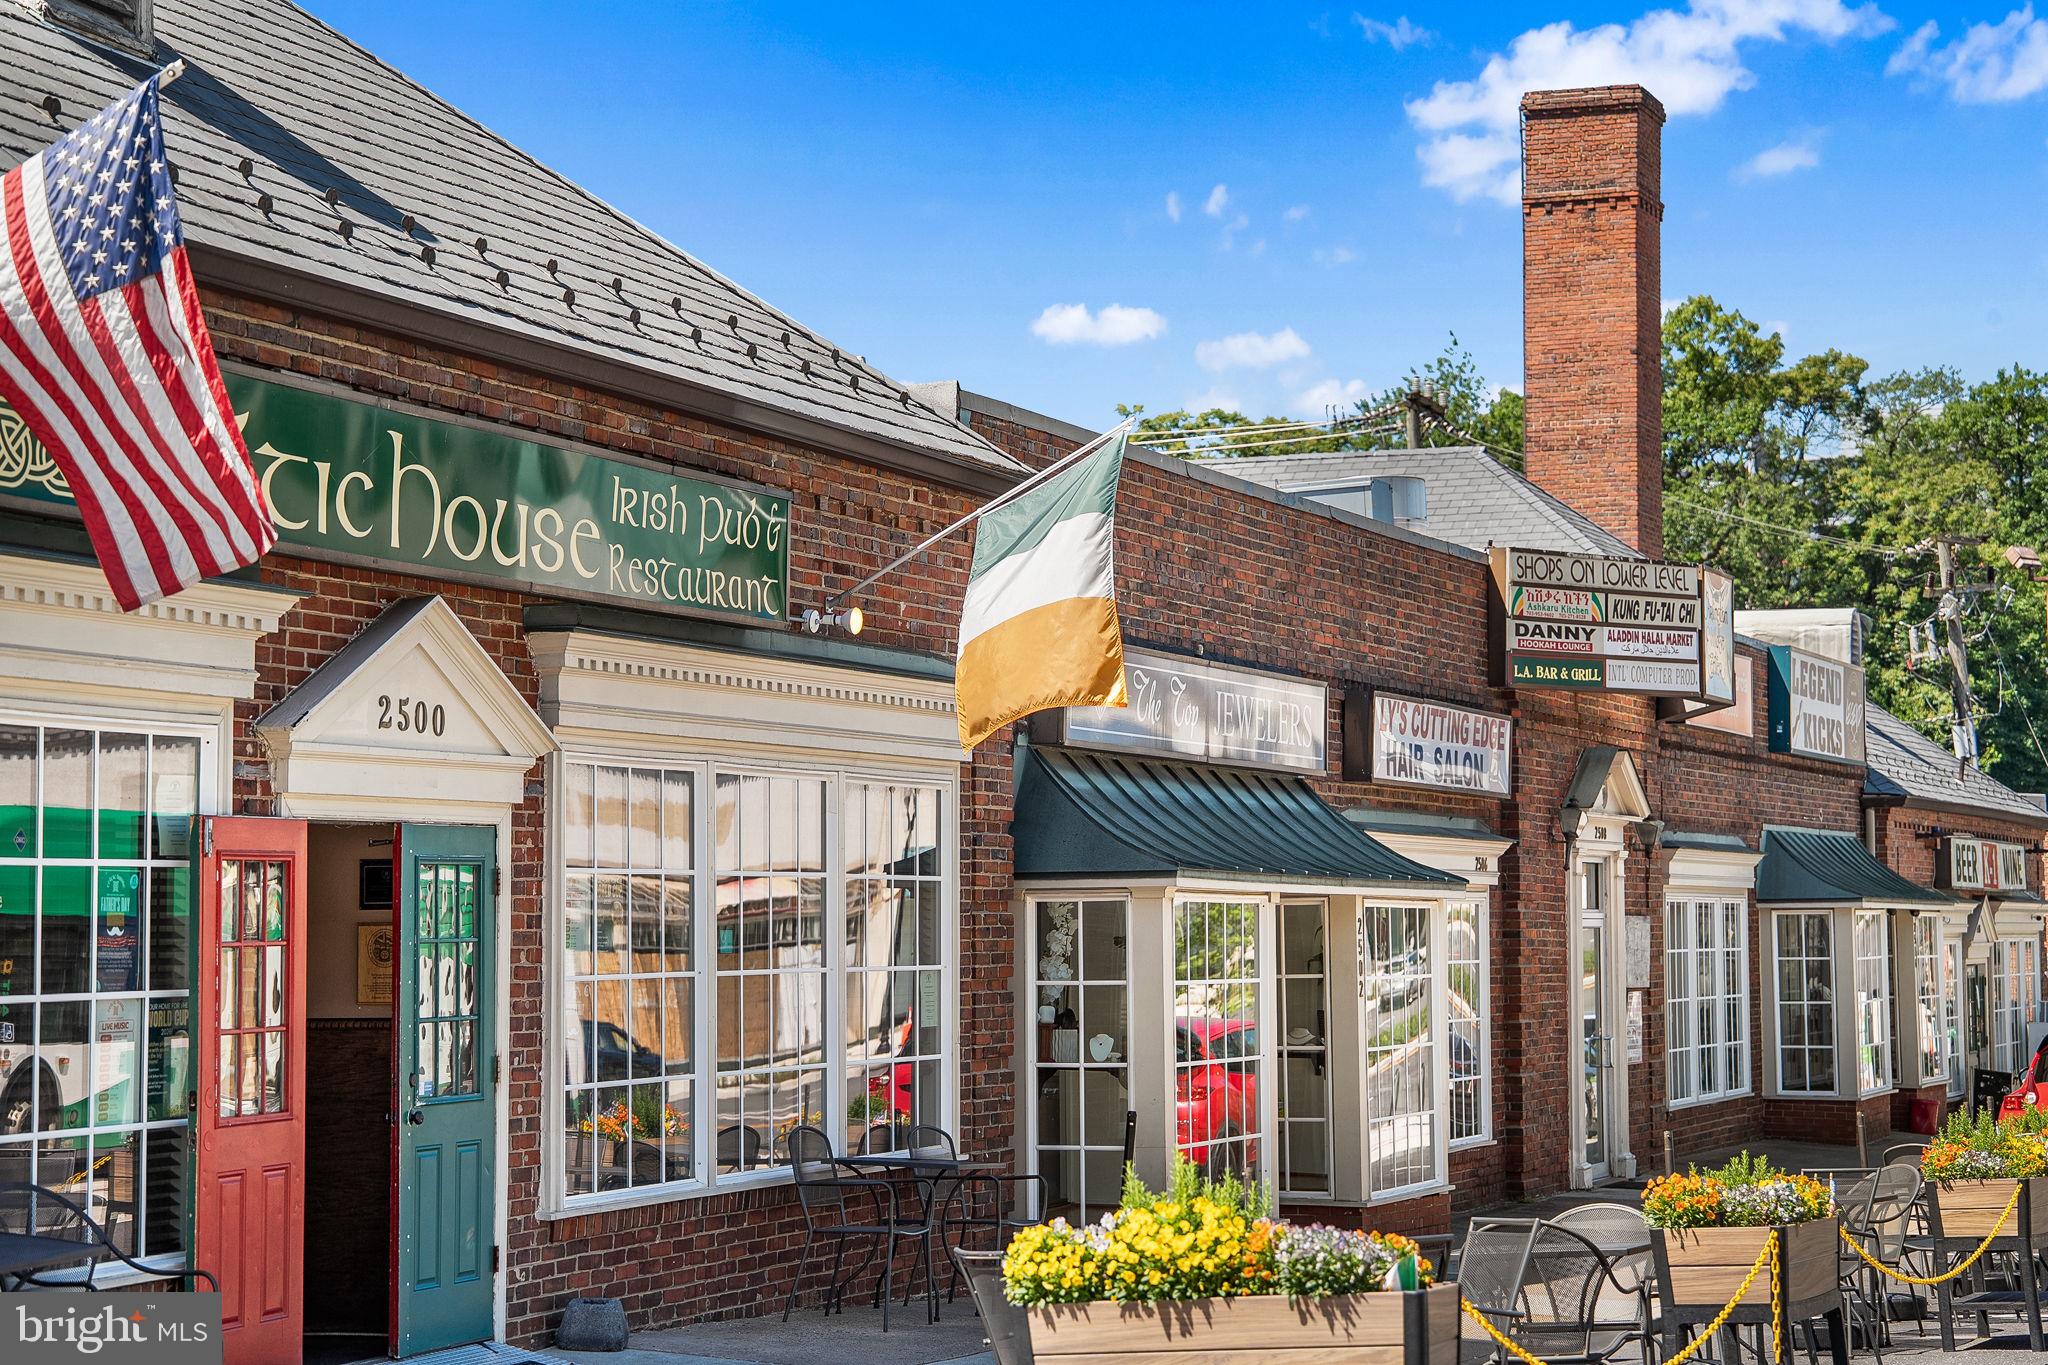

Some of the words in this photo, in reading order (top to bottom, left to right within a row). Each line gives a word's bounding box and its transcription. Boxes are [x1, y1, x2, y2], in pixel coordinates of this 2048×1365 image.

[612, 475, 687, 535] Irish
[767, 502, 781, 552] &
[608, 543, 779, 616] Restaurant
[1516, 555, 1563, 581] SHOPS
[1570, 559, 1595, 584] ON
[1602, 562, 1648, 588] LOWER
[1654, 566, 1689, 591] LEVEL
[1527, 602, 1559, 612] Ashkaru
[1561, 605, 1589, 615] Kitchen
[1613, 598, 1640, 621] KUNG
[1643, 600, 1674, 623] FU-TAI
[1679, 602, 1696, 624] CHI
[1515, 622, 1596, 641] DANNY
[1520, 640, 1557, 650] HOOKAH
[1558, 642, 1591, 651] LOUNGE
[1607, 629, 1639, 643] ALADDIN
[1641, 631, 1664, 645] HALAL
[1666, 633, 1693, 647] MARKET
[1514, 665, 1533, 678] L.A.
[1536, 665, 1558, 679] BAR
[1560, 667, 1568, 679] &
[1571, 668, 1601, 681] GRILL
[1631, 665, 1672, 685] COMPUTER
[1675, 668, 1698, 685] PROD.
[1792, 658, 1842, 706] LEGEND
[378, 694, 445, 736] 2500
[1133, 669, 1162, 726] The
[1170, 676, 1199, 738] Top
[1214, 690, 1312, 748] JEWELERS
[1380, 699, 1407, 736] LY'S
[1411, 704, 1469, 745] CUTTING
[1472, 715, 1505, 750] EDGE
[1803, 711, 1842, 756] KICKS
[1386, 740, 1424, 780] HAIR
[1434, 746, 1484, 788] SALON
[1955, 843, 1979, 884] BEER
[2002, 848, 2023, 885] WINE
[102, 1022, 113, 1031] LIVE
[113, 1021, 129, 1030] MUSIC
[175, 1009, 189, 1026] CUP
